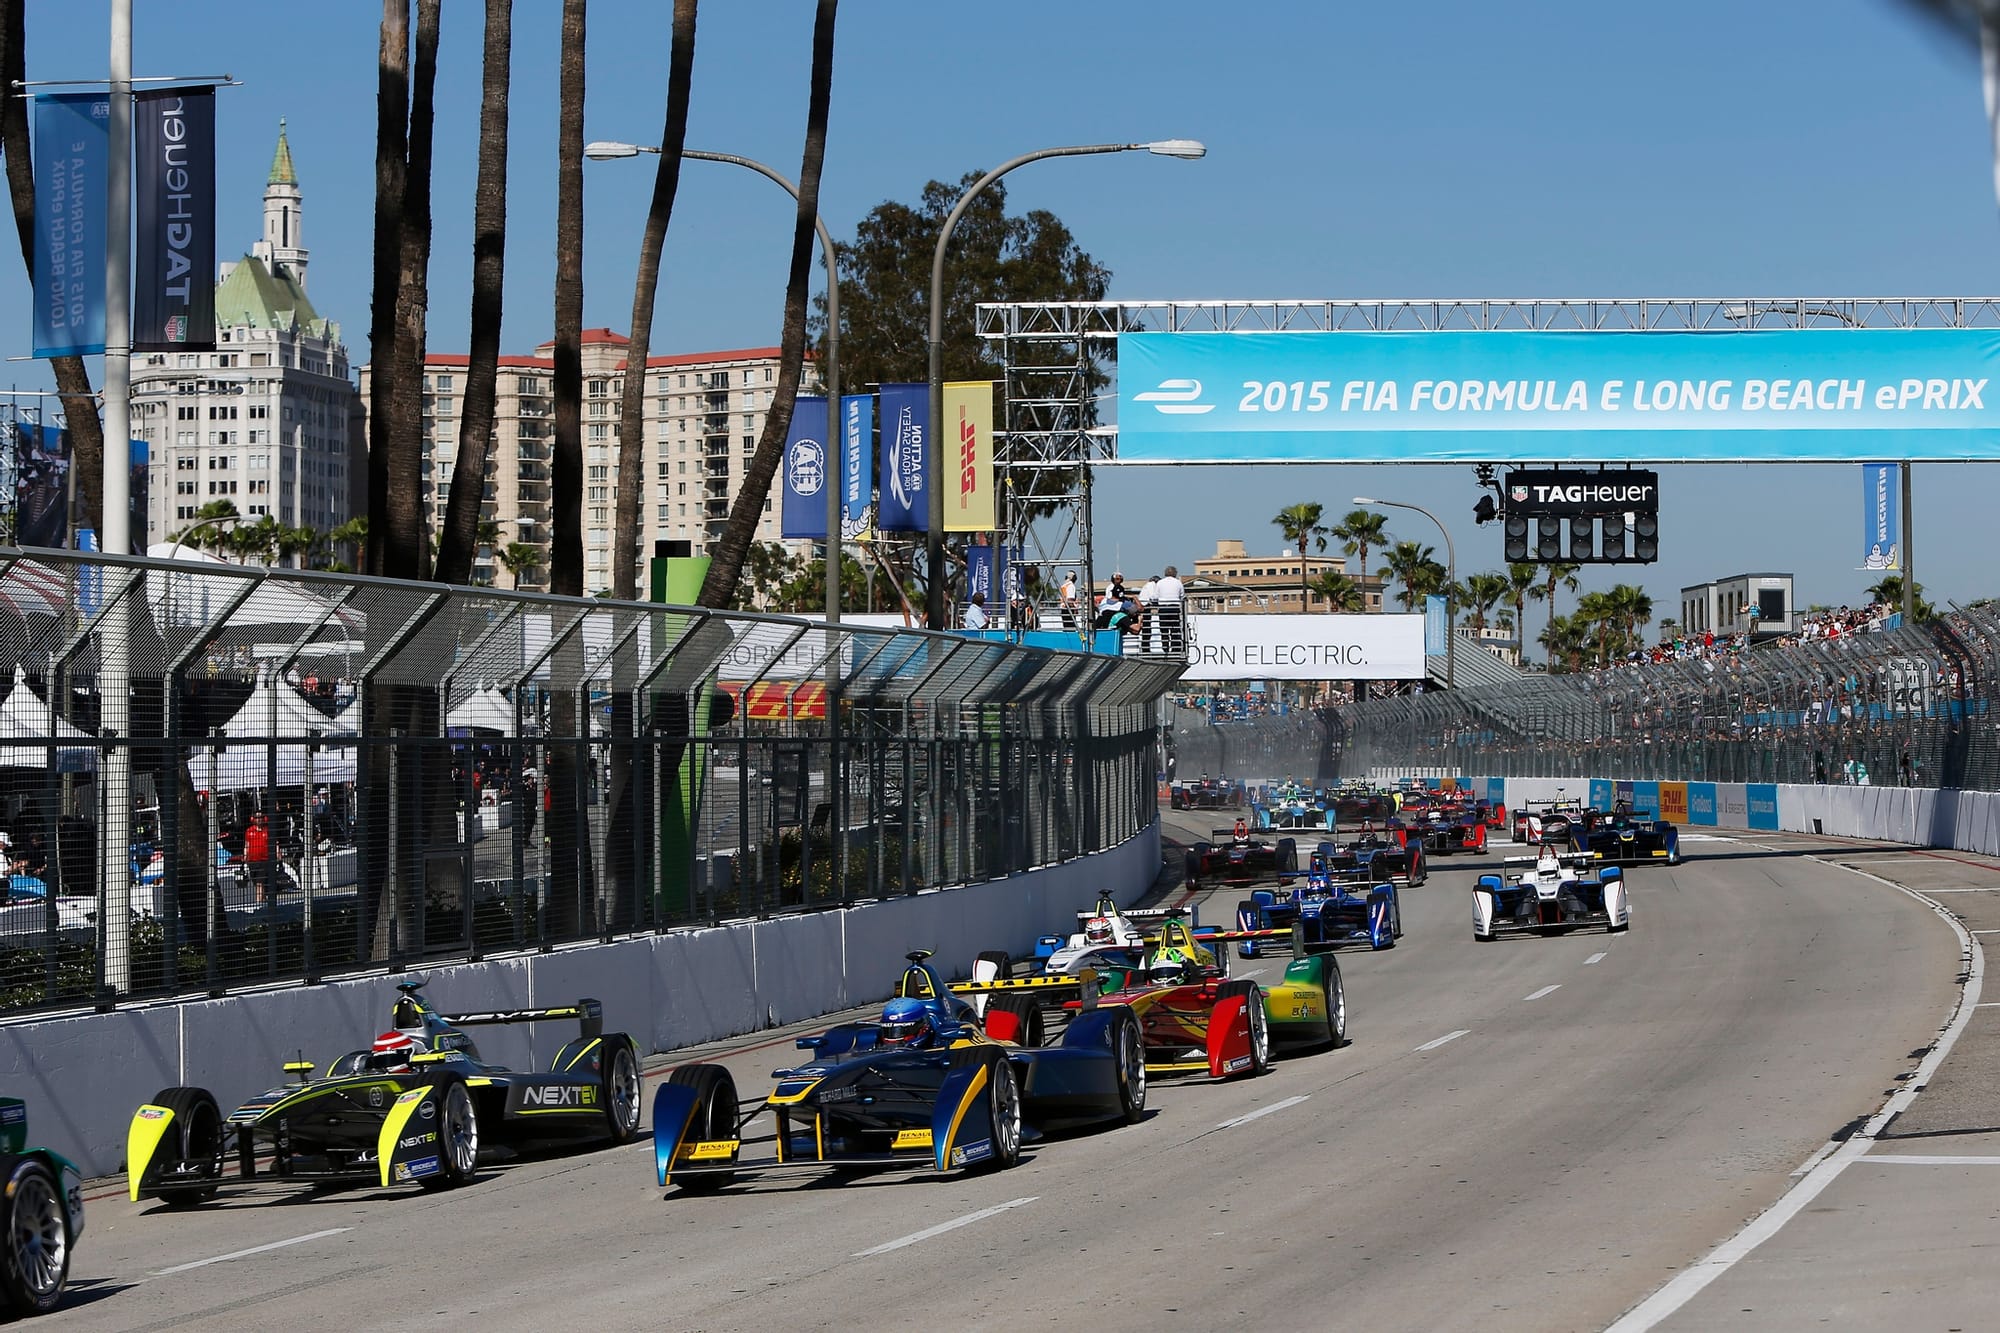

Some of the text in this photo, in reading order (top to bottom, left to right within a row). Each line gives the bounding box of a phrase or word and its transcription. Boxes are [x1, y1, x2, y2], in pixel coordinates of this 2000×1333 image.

[1238, 378, 1989, 412] 2015 FIA FORMULA E LONG BEACH ePRIX
[1533, 485, 1653, 503] TAGHeuer
[1187, 644, 1369, 665] ORN ELECTRIC.
[1890, 662, 1928, 671] SPEED
[1893, 674, 1921, 684] LIMI
[1895, 688, 1922, 707] 40
[523, 1085, 597, 1105] NEXTEV
[400, 1131, 437, 1149] NEXTEV
